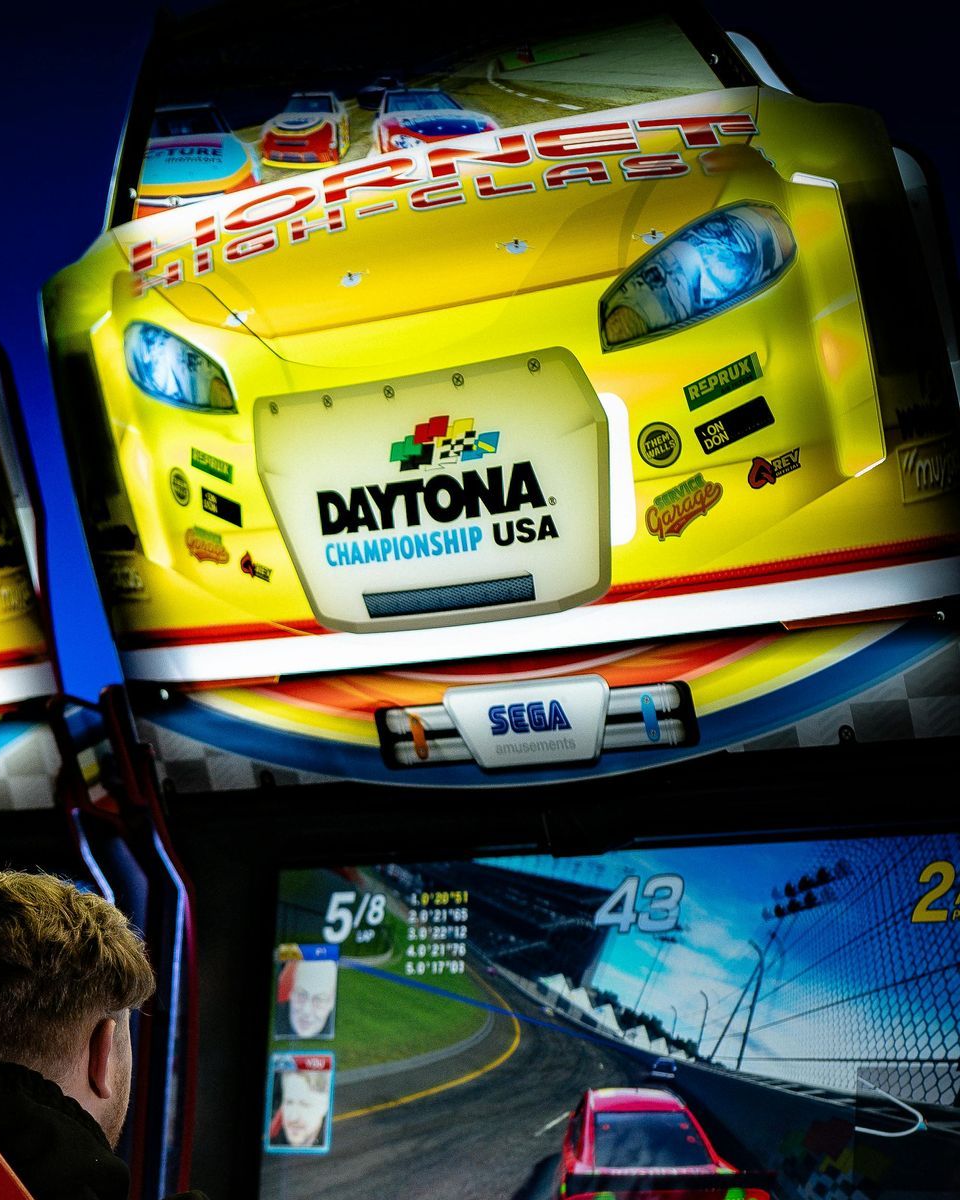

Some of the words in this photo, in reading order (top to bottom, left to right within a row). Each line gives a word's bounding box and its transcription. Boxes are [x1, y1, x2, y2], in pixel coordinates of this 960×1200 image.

[130, 112, 760, 274] HORNET
[688, 357, 752, 401] REPRUX
[644, 430, 671, 450] THEM
[645, 439, 677, 459] WALLS
[703, 430, 730, 450] DON
[316, 460, 548, 536] DAYTONA
[645, 481, 724, 542] Garage
[653, 473, 707, 510] SERVICE
[325, 525, 483, 567] CHAMPIONSHIP
[492, 514, 560, 547] USA
[488, 699, 572, 736] SEGA
[495, 737, 577, 755] amusements
[594, 873, 684, 933] 43
[911, 860, 956, 923] 2
[322, 890, 387, 944] 5/8
